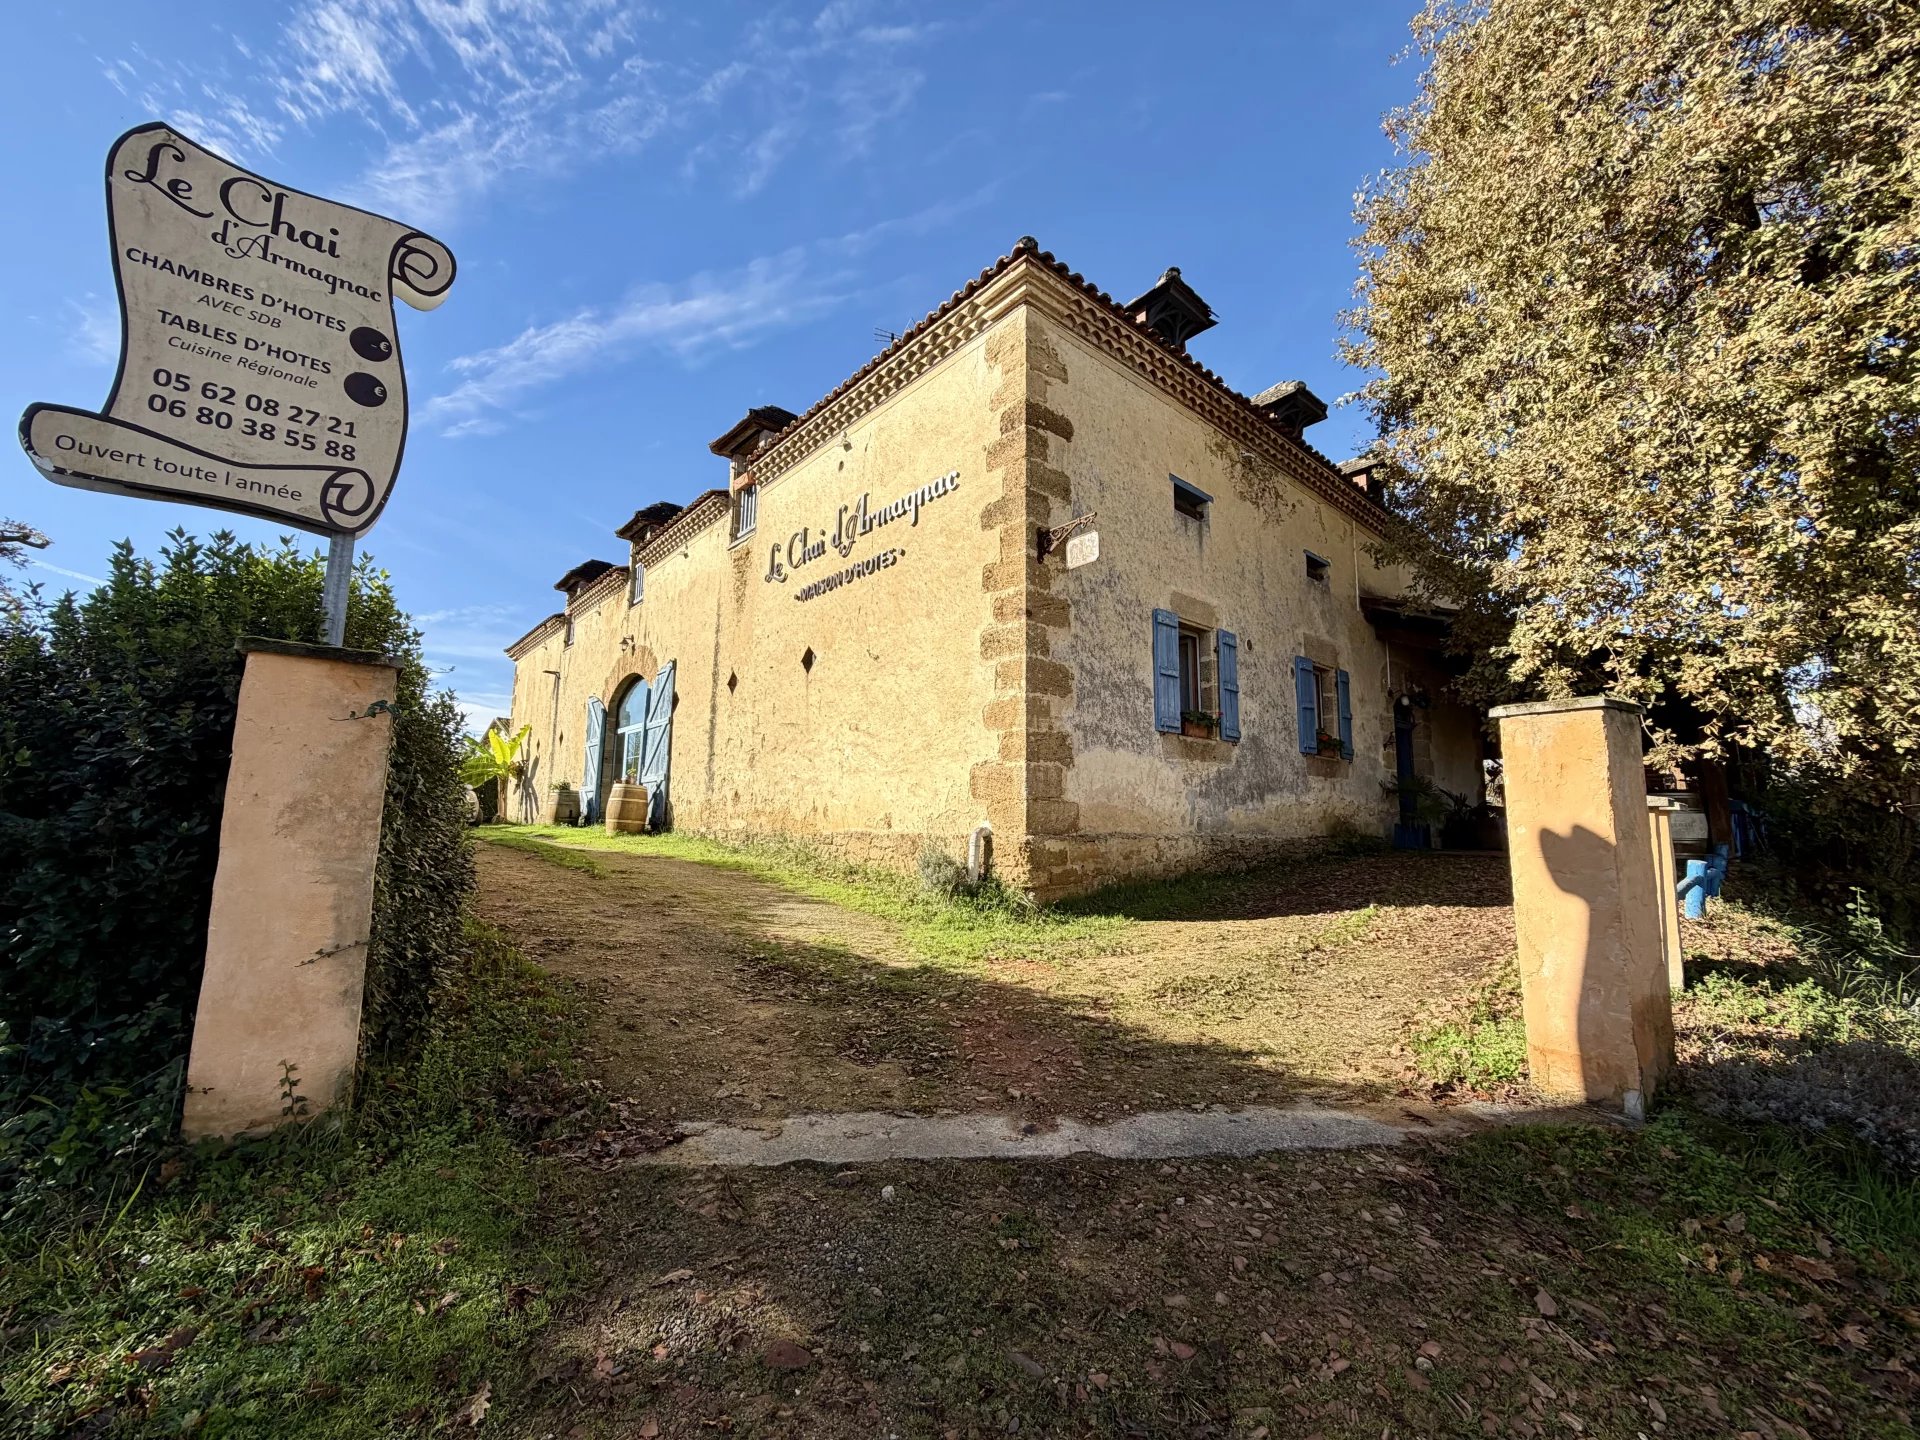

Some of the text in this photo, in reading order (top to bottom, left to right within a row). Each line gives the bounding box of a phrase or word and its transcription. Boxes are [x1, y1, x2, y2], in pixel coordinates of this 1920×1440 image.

[125, 143, 340, 259] Le Chai
[126, 247, 255, 301] CHAMBRES
[157, 309, 237, 345] TABLES
[197, 294, 282, 328] AVEC SDB
[168, 336, 318, 389] Cuisine Régionale
[147, 394, 356, 461] 06 80 38 55 88
[153, 368, 357, 438] 05 62 08 27 21
[55, 434, 146, 467] Ouvert
[153, 456, 217, 482] toute
[764, 543, 788, 583] Le
[787, 527, 827, 569] Chai
[799, 570, 844, 602] MAISON
